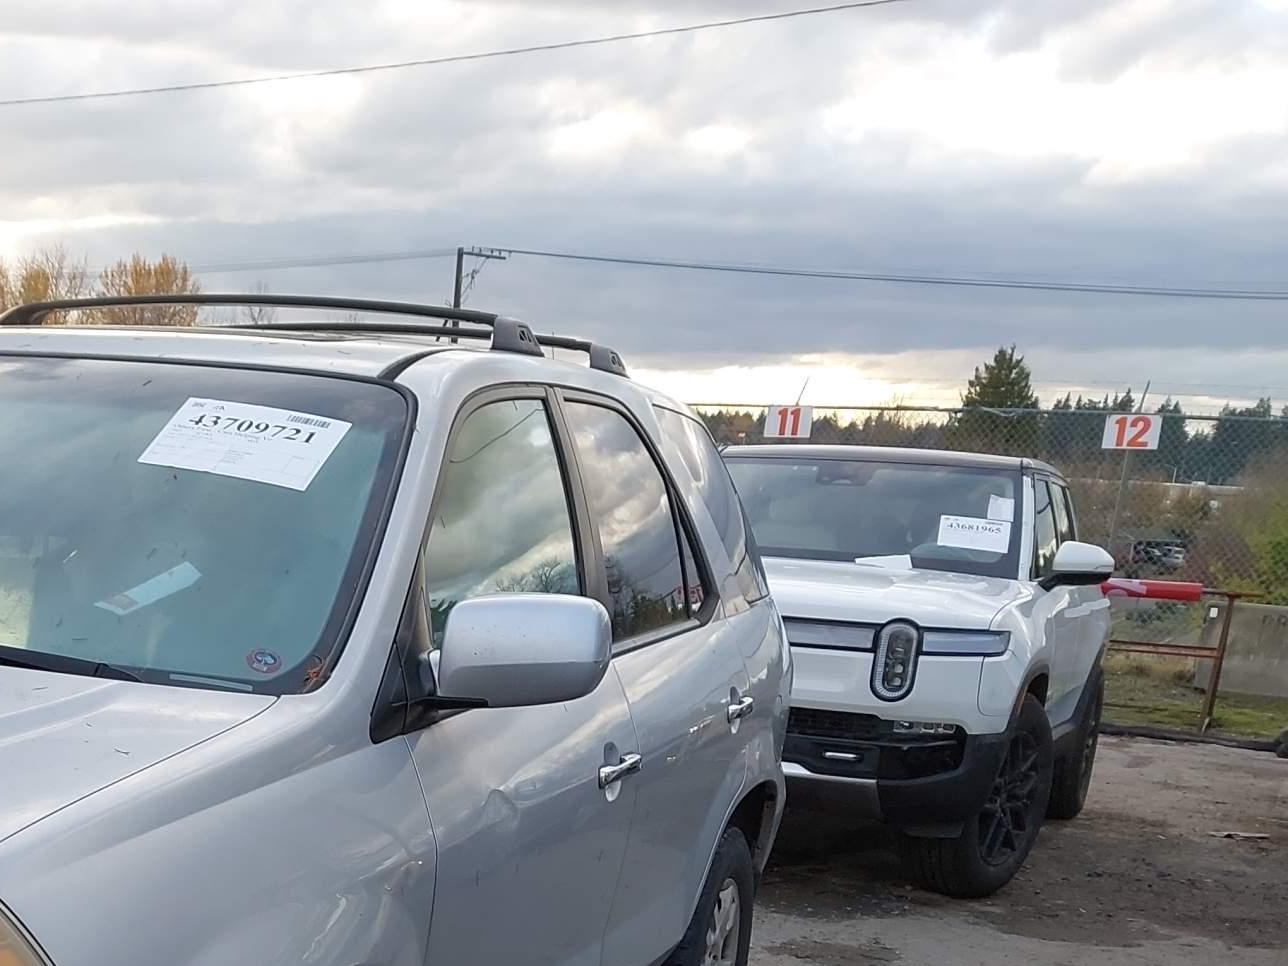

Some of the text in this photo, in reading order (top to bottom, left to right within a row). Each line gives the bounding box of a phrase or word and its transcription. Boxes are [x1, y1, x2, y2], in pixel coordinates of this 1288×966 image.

[189, 414, 317, 444] 43709721
[778, 407, 802, 436] 11
[1115, 416, 1152, 447] 12
[947, 522, 1002, 534] 43681965
